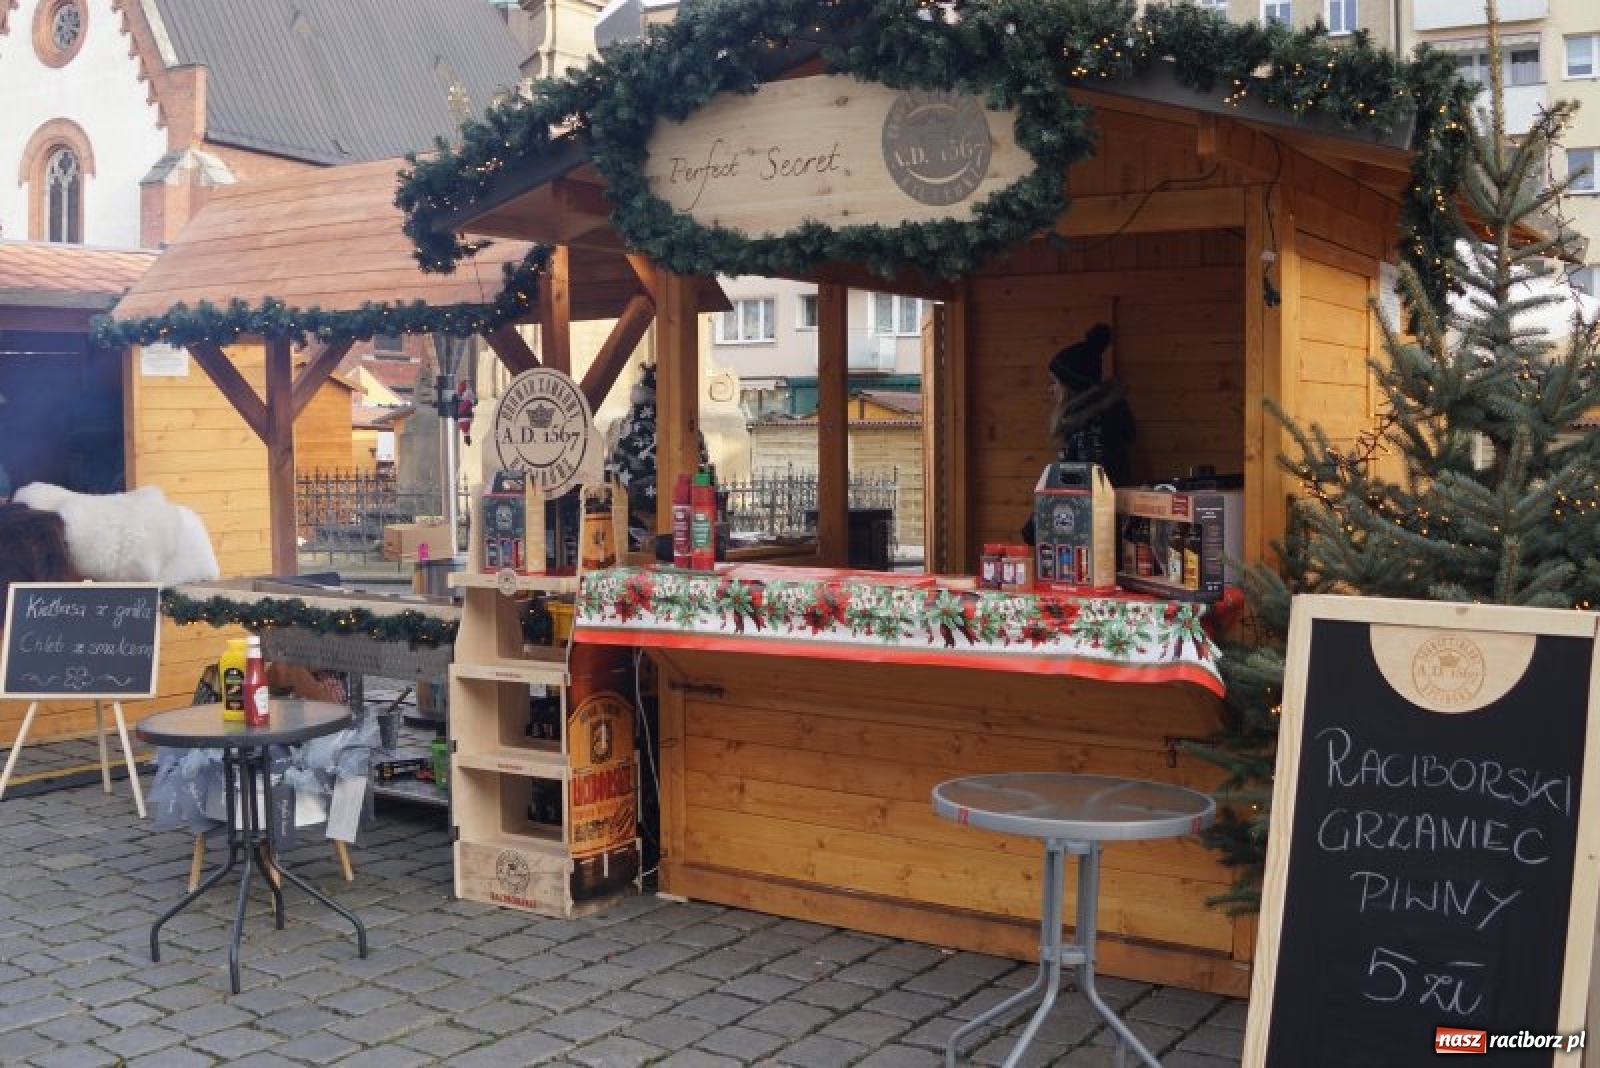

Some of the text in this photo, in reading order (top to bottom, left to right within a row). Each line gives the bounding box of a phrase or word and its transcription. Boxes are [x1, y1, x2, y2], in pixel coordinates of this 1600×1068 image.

[669, 138, 840, 212] Perfect Secret
[542, 423, 581, 452] 1567
[1314, 727, 1571, 816] RACIBORSKI
[1317, 808, 1549, 864] GRZANIEC
[1350, 871, 1523, 930] PIWNY
[1361, 947, 1418, 1001] 5
